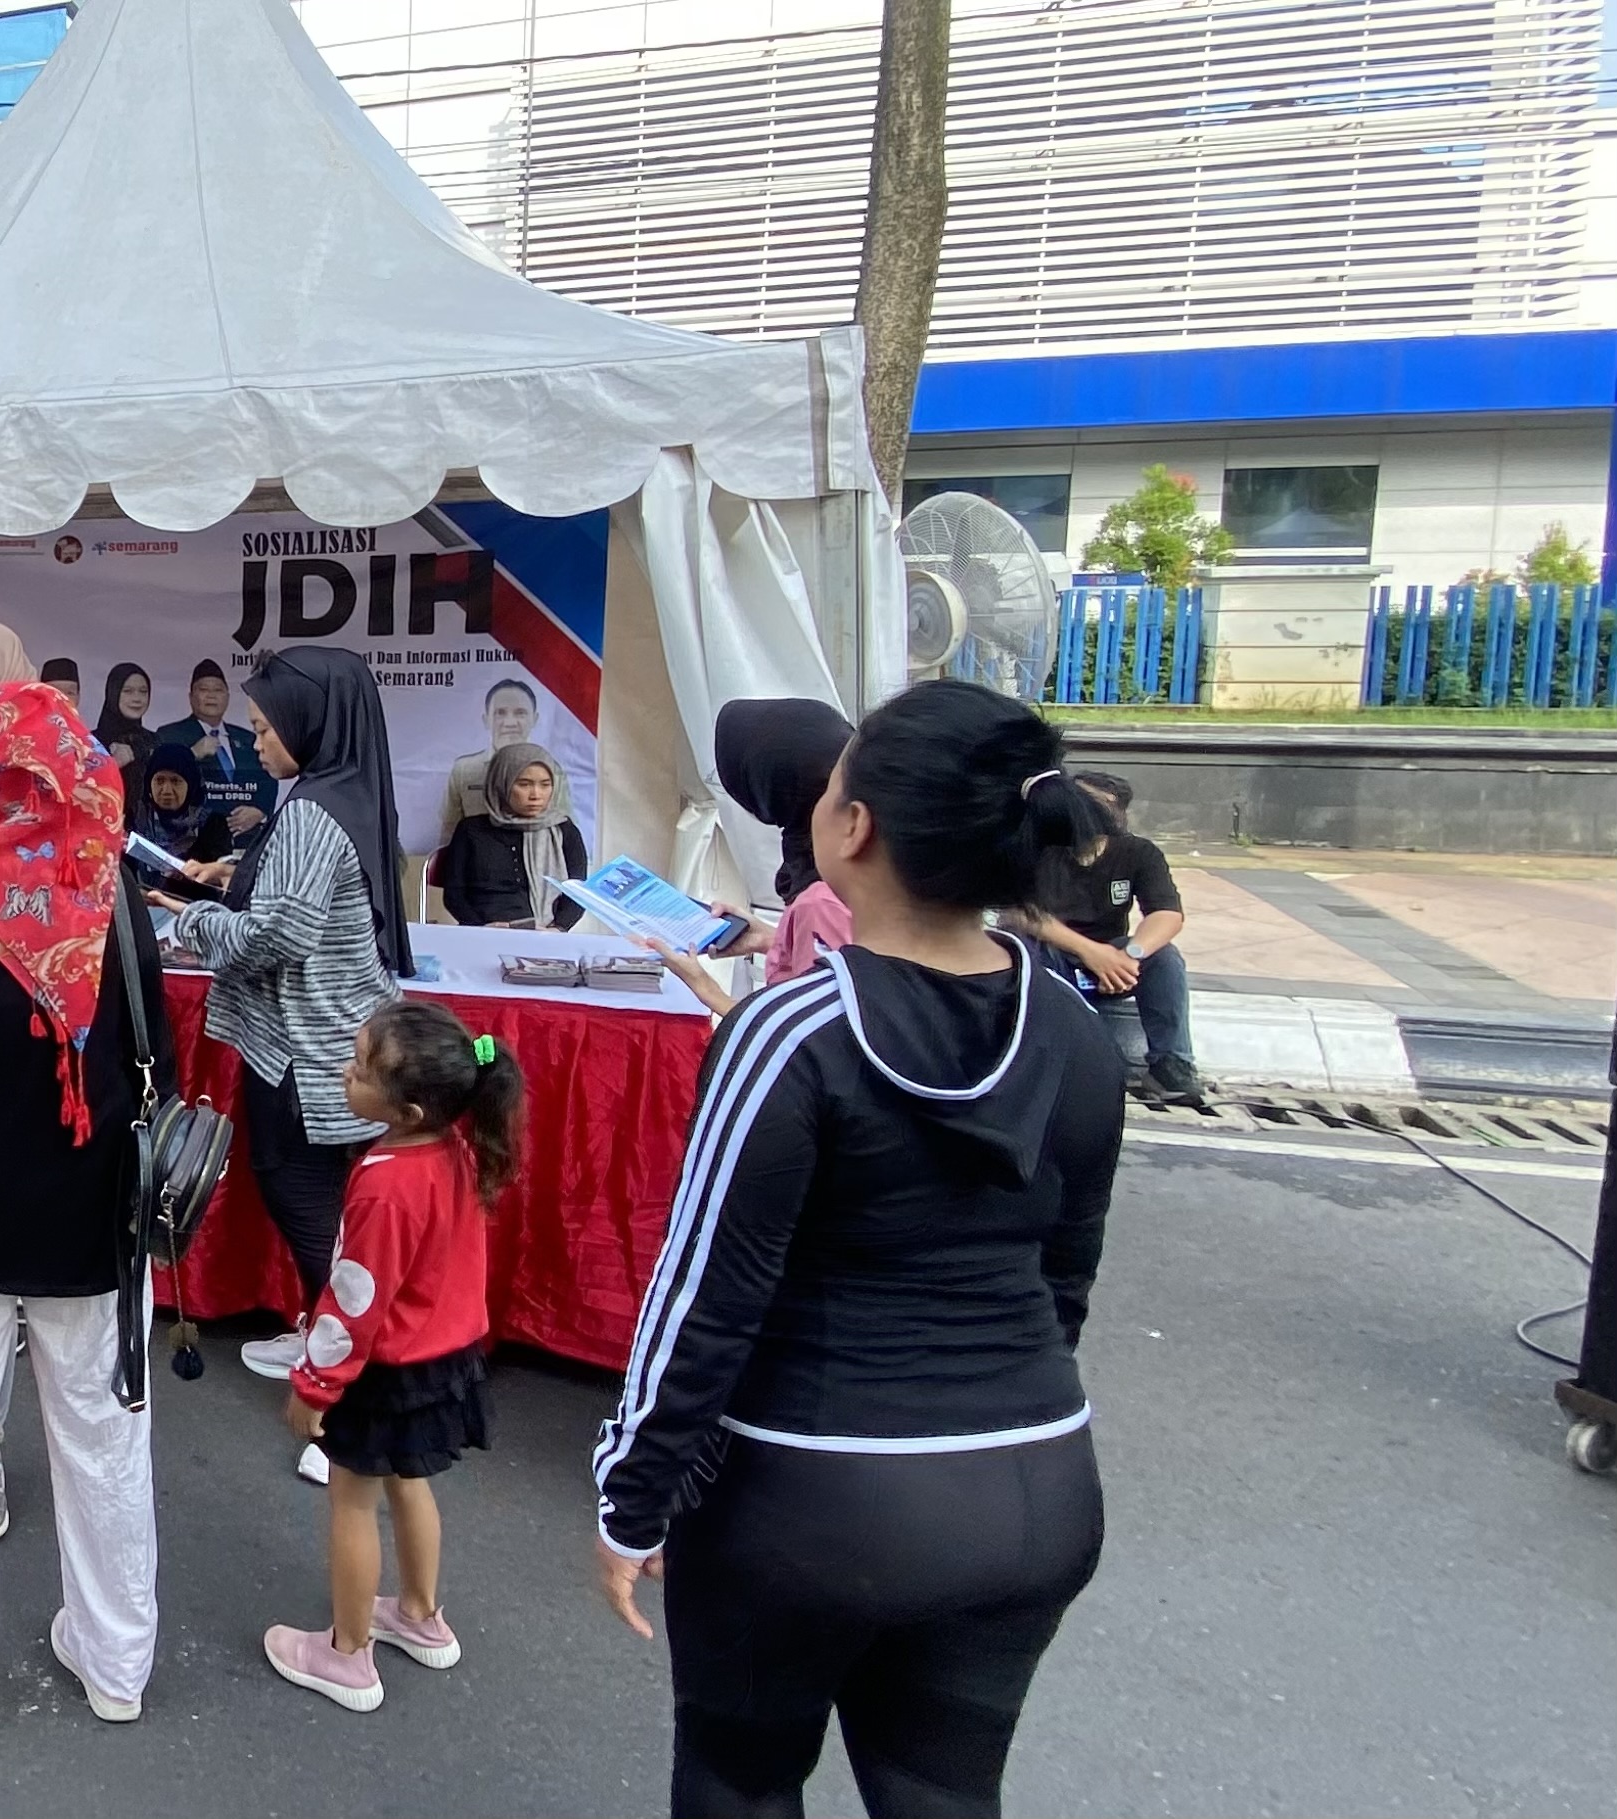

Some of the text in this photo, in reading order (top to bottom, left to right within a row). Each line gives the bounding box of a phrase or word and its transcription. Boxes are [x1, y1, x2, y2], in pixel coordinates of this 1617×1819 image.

[108, 542, 178, 553] semarang
[242, 528, 377, 557] SOSIALISASI
[232, 549, 494, 651] JDIH
[231, 653, 254, 668] Jari
[377, 651, 402, 665] Dan
[406, 649, 470, 664] Informasi
[376, 669, 454, 687] Semarang
[225, 792, 252, 801] DPRD
